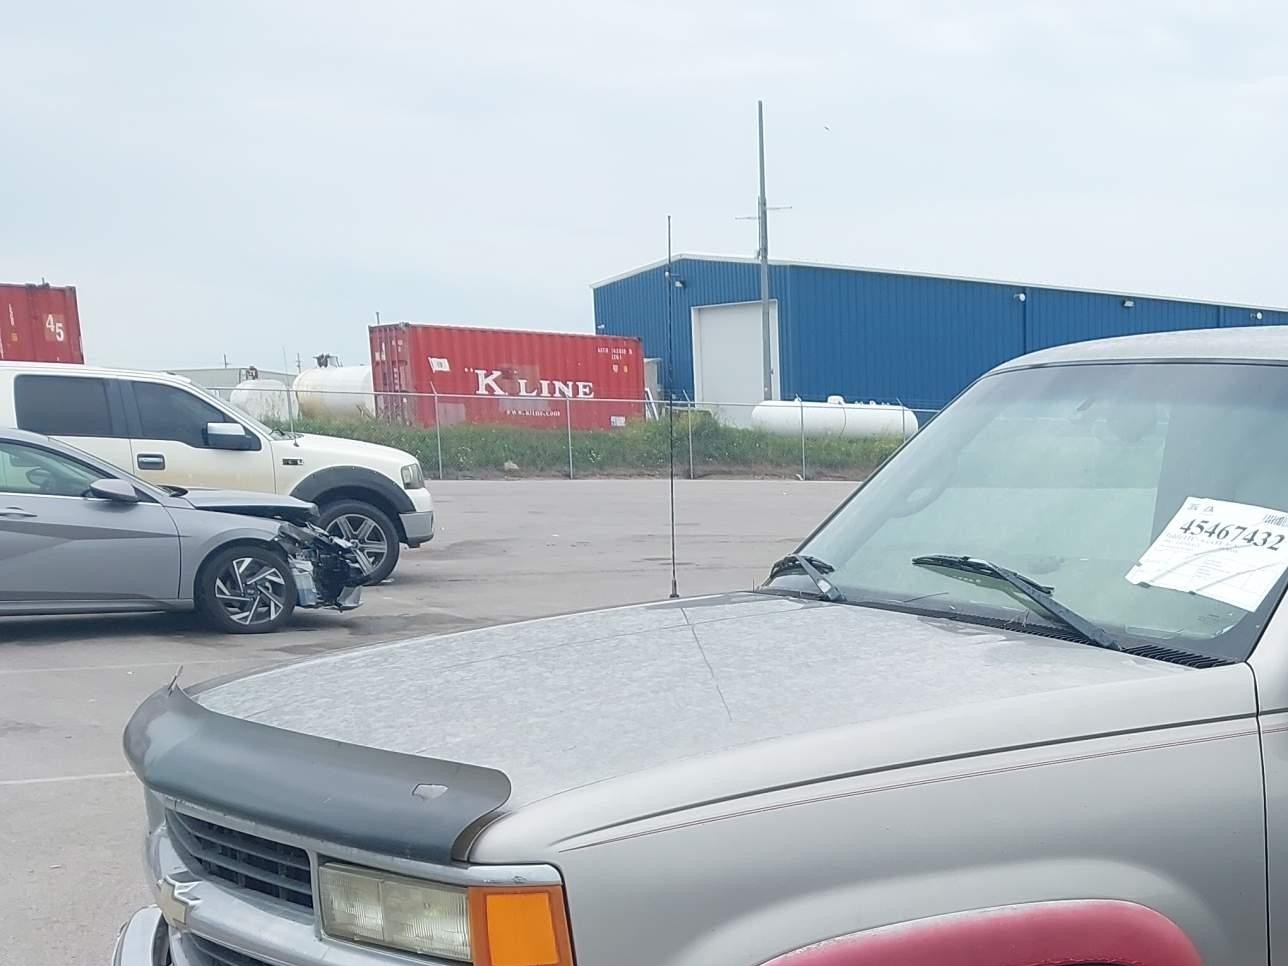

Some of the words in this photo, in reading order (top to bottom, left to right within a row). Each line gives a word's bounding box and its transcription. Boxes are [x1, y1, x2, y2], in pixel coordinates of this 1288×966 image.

[46, 313, 64, 341] 45
[517, 379, 595, 398] LINE
[1179, 518, 1286, 551] 45467432
